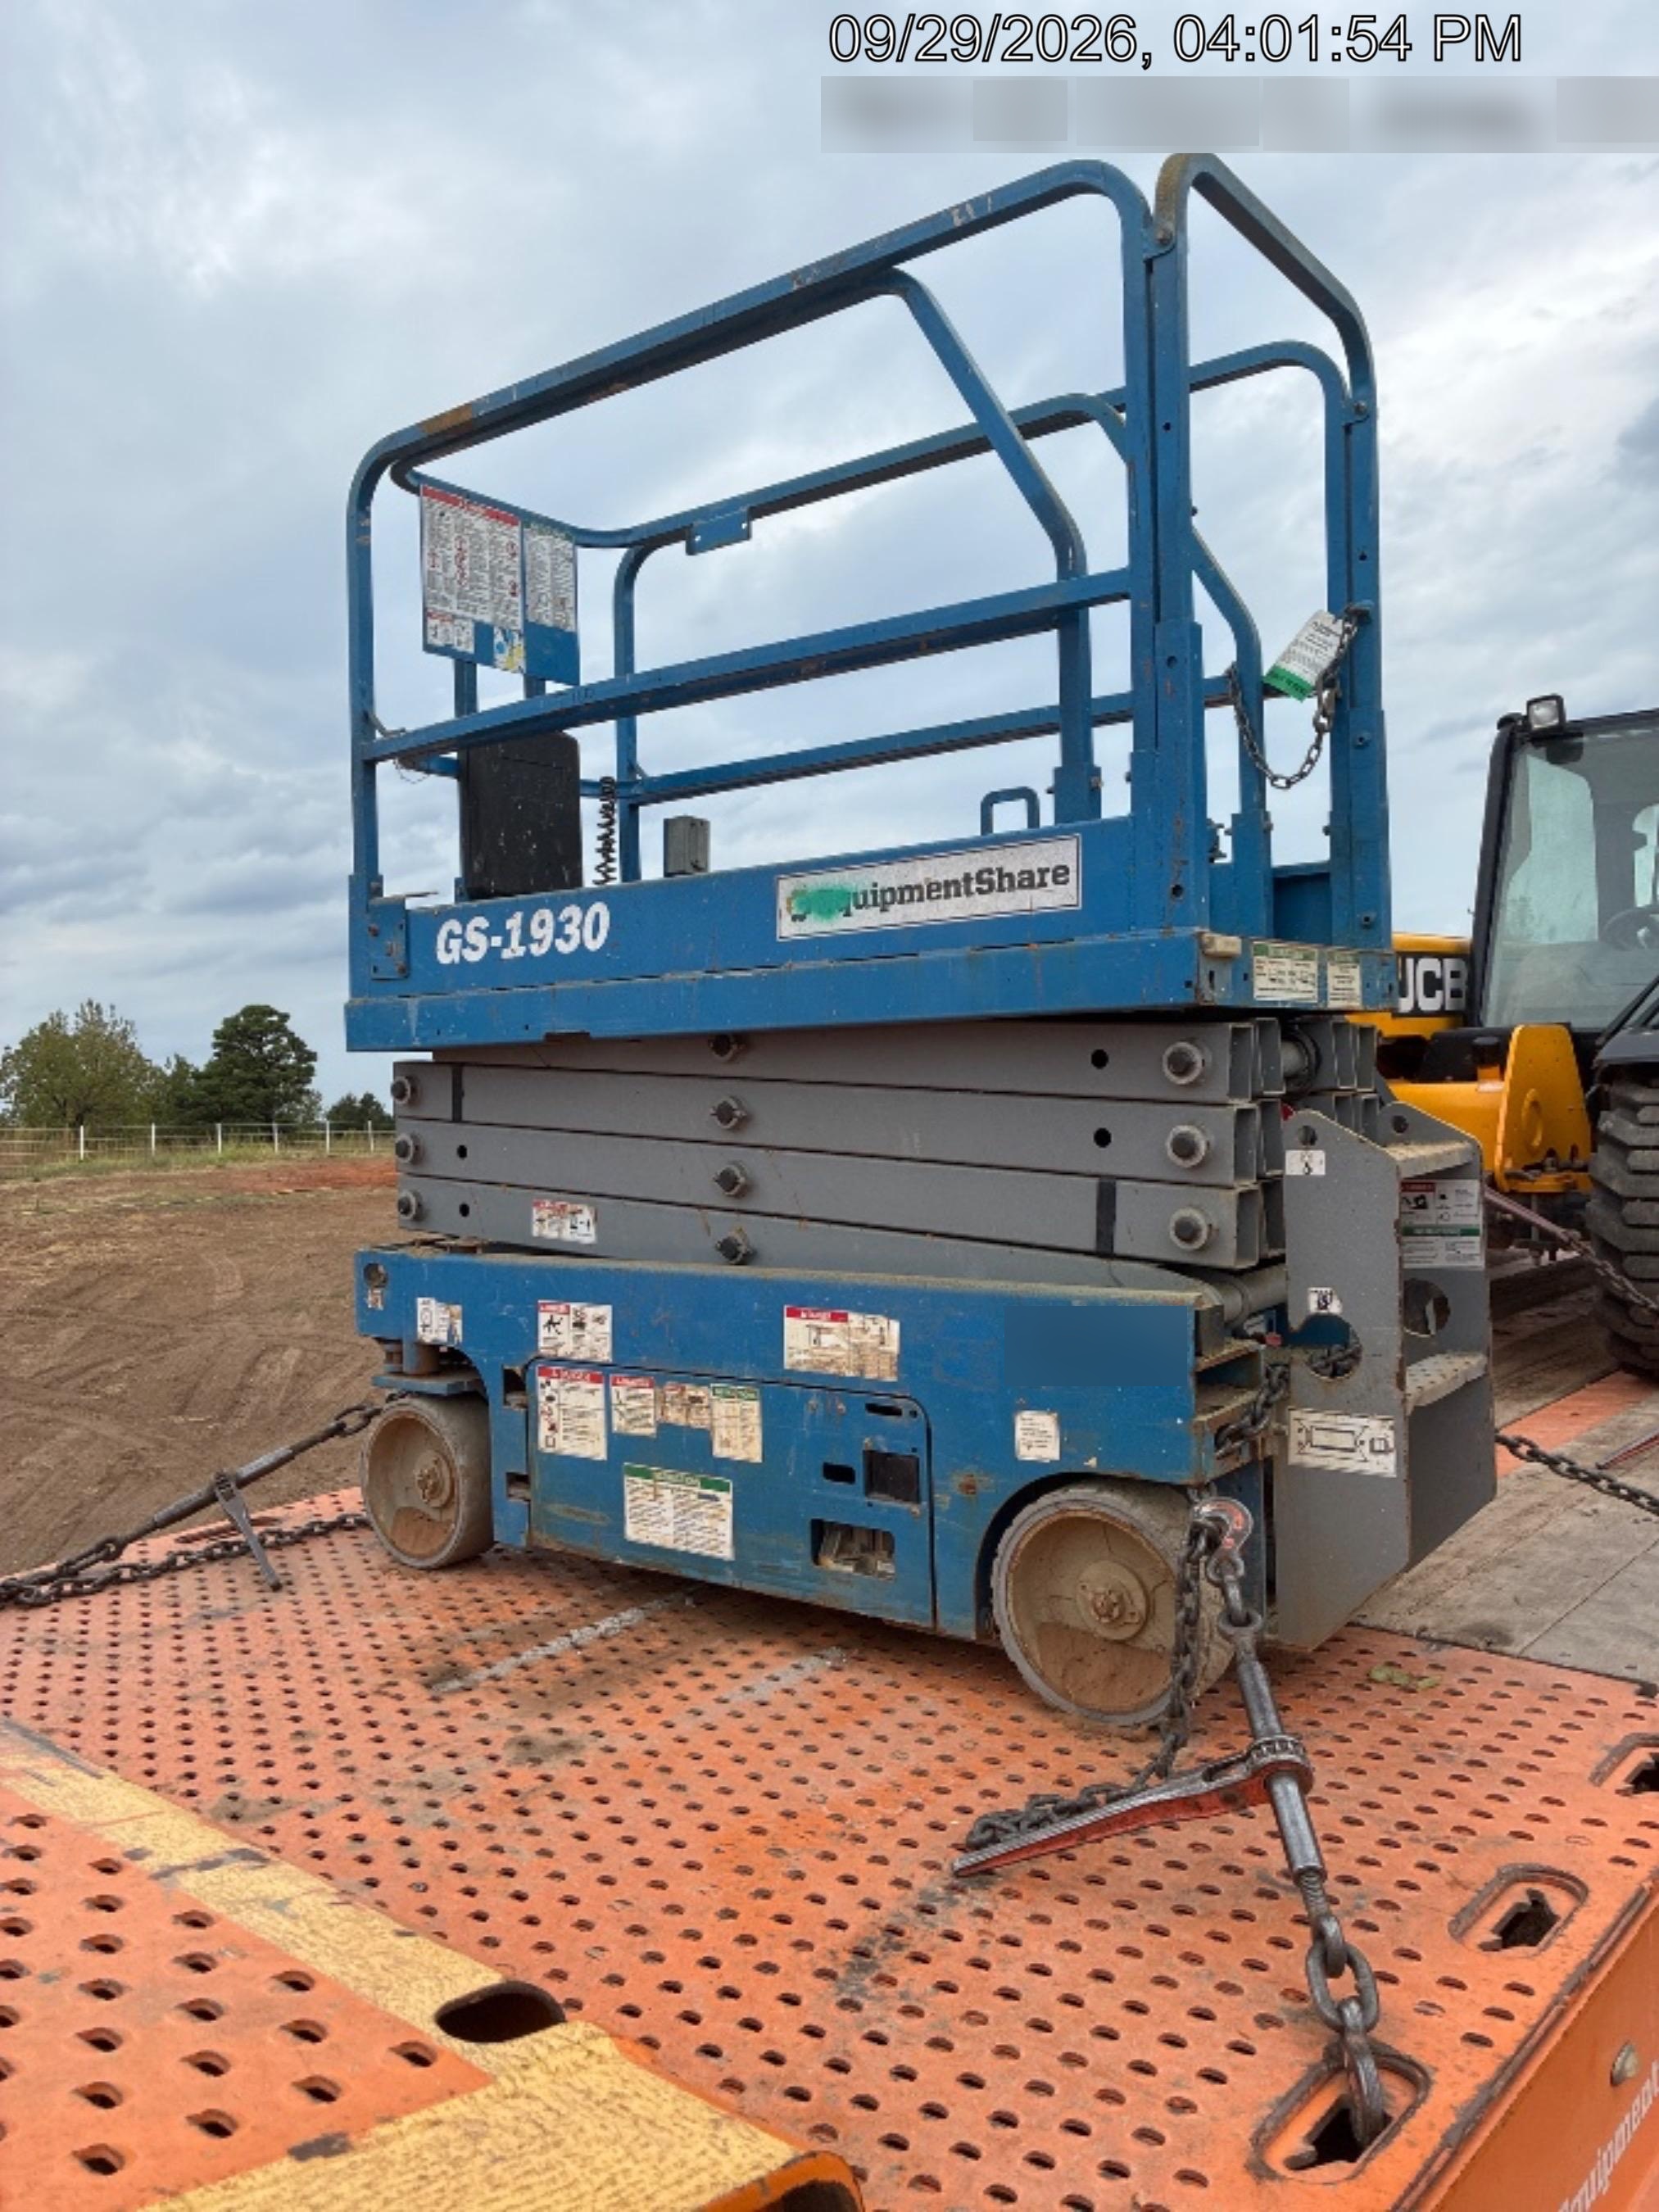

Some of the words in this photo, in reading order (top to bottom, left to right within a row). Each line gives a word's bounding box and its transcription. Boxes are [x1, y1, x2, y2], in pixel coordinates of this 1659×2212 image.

[816, 863, 1070, 918] quipmentShare
[437, 902, 610, 964] GS-1930
[1398, 957, 1468, 1013] JCB
